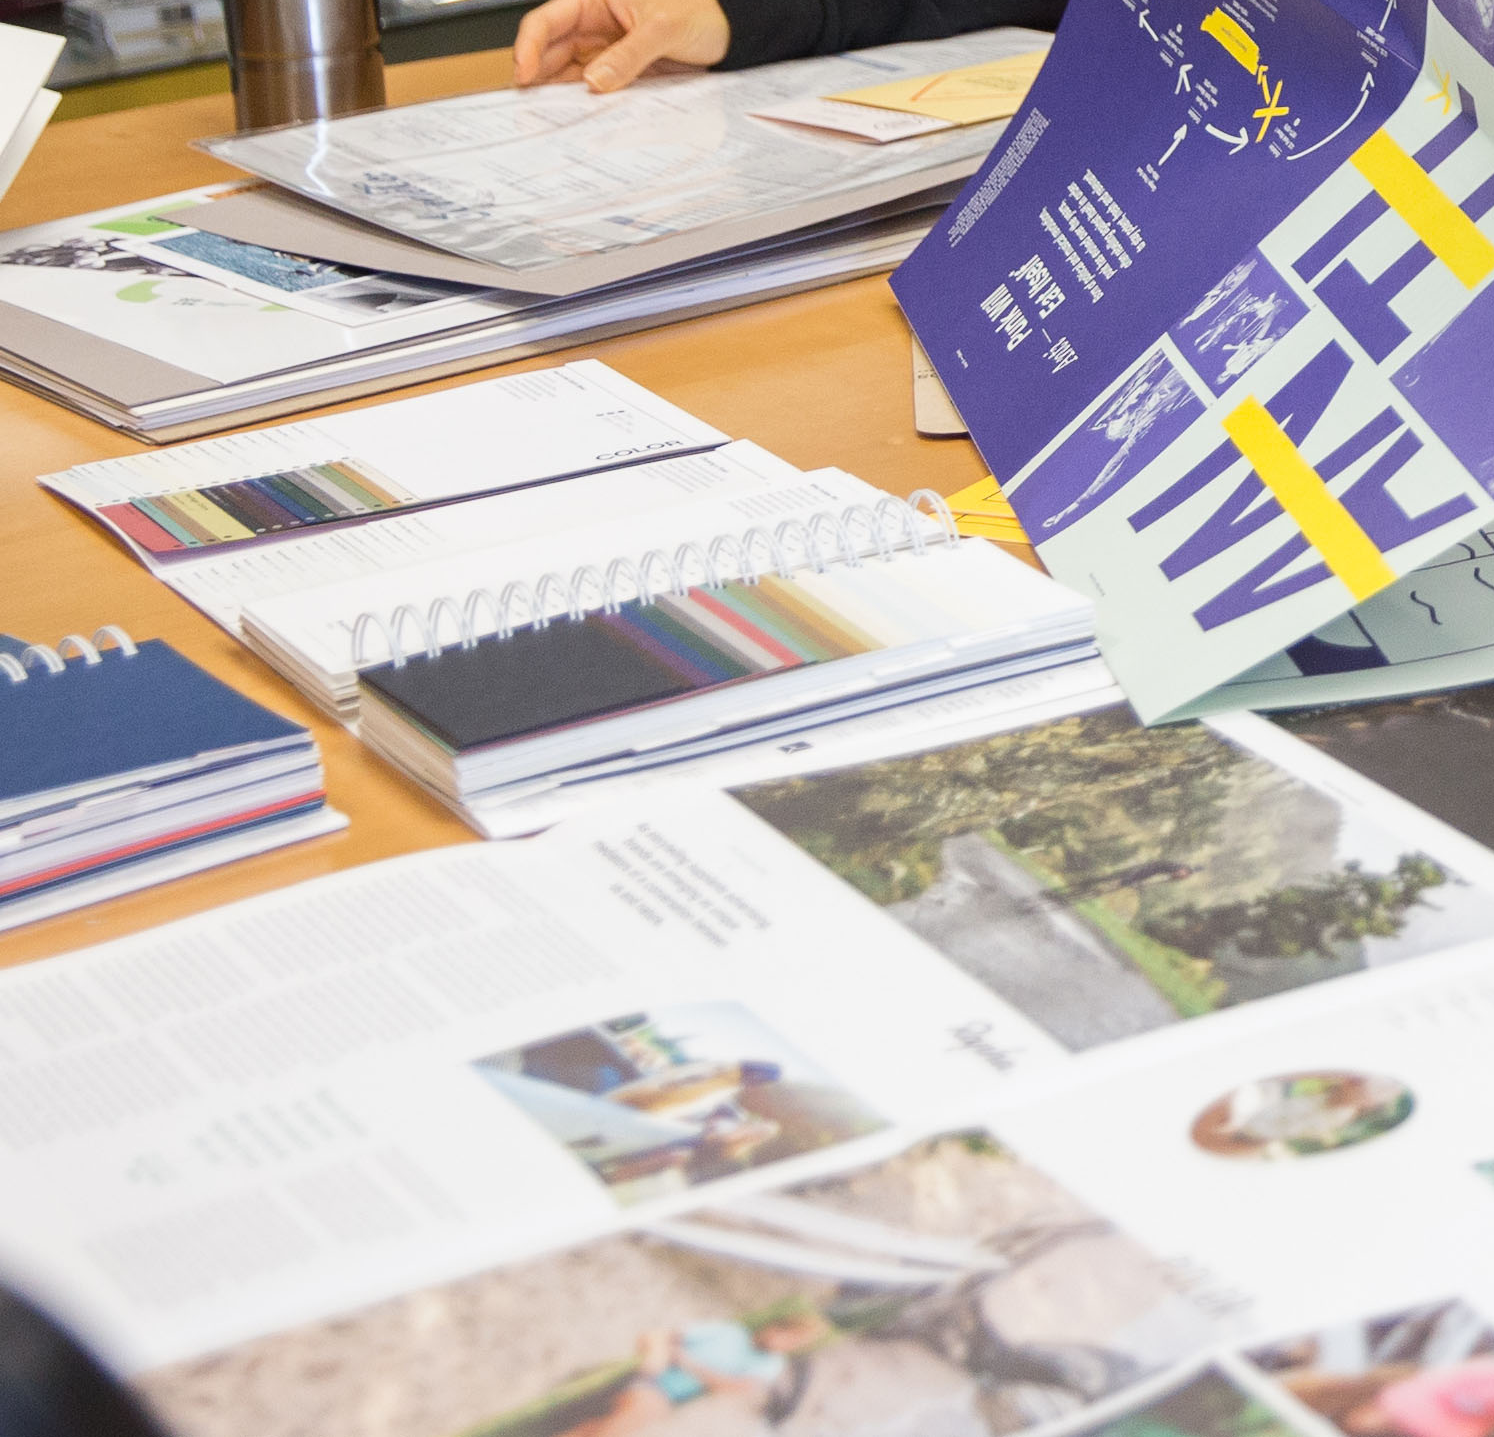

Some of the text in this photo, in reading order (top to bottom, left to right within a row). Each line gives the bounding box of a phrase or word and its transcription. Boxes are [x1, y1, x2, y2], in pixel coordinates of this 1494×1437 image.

[980, 283, 1033, 352] Punk Will
[1035, 282, 1065, 319] Eat
[1042, 336, 1078, 373] Anti
[595, 439, 684, 461] COLOR
